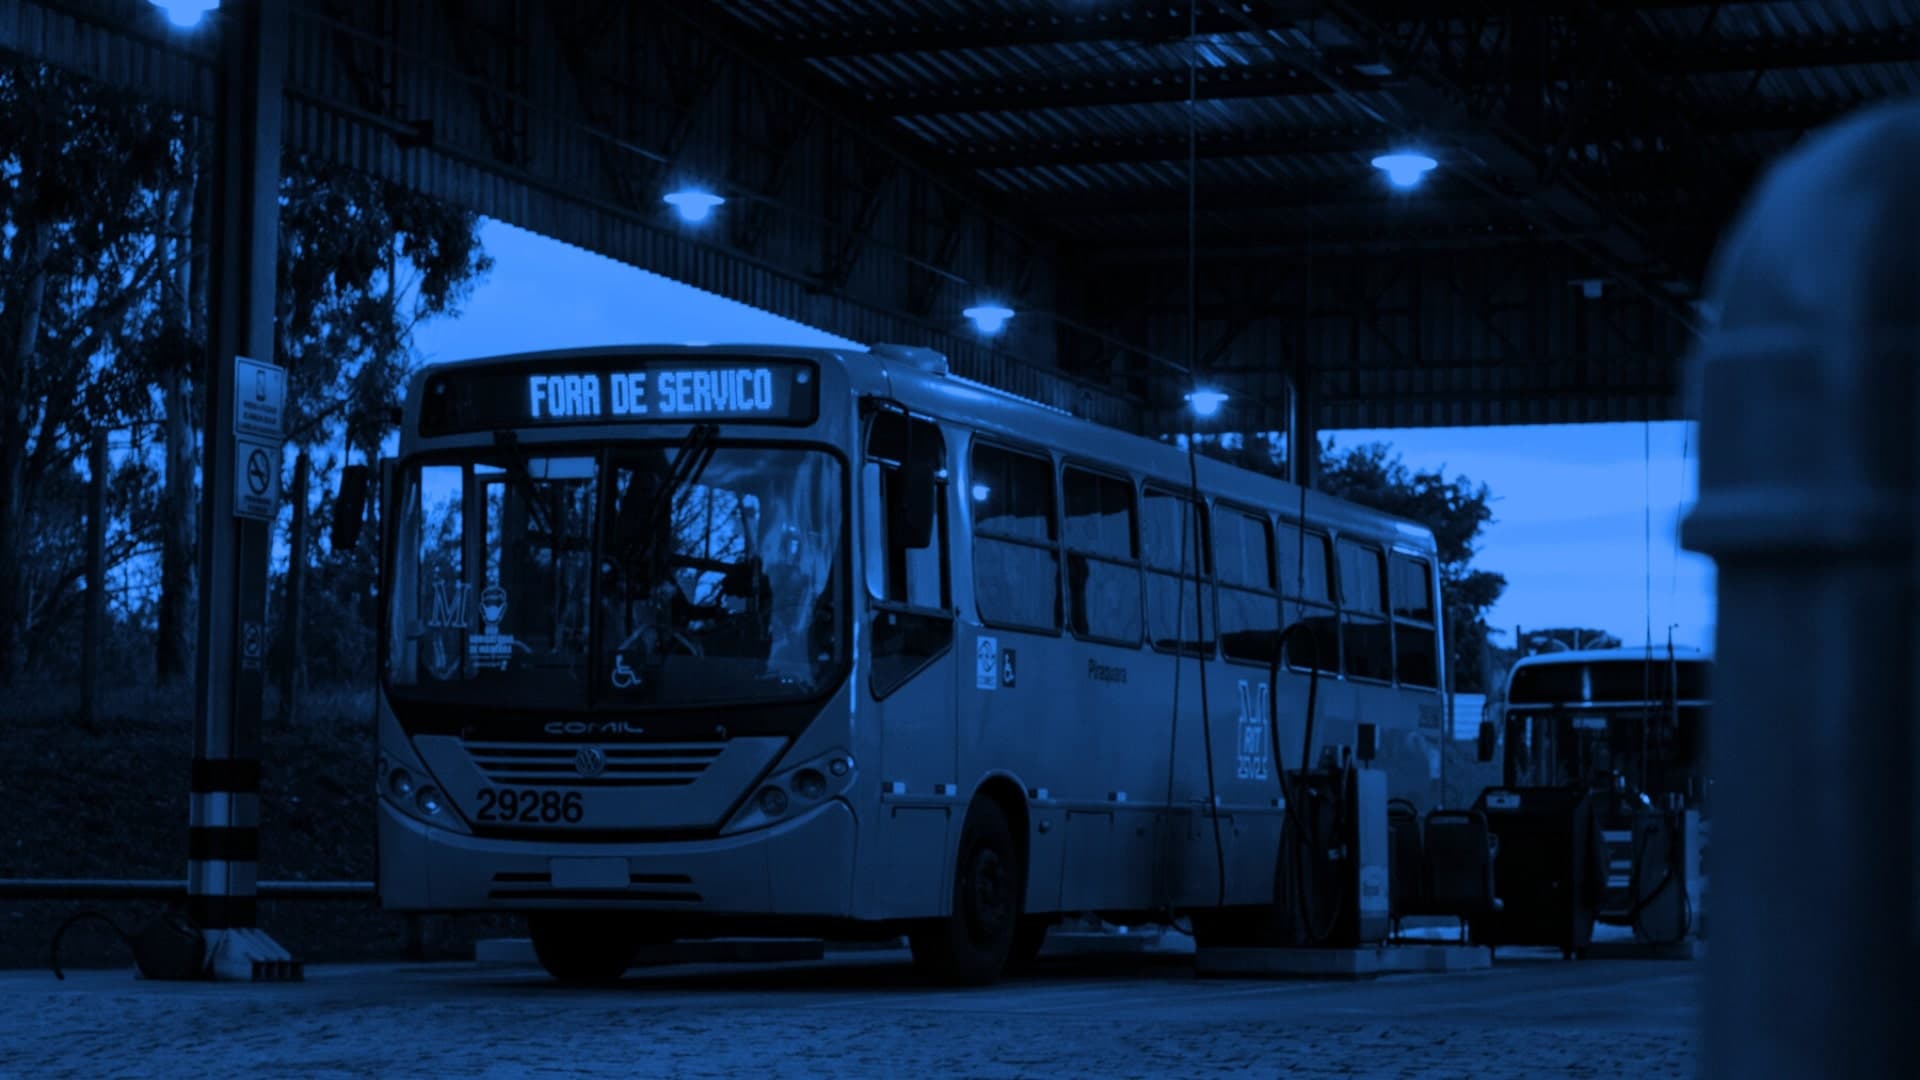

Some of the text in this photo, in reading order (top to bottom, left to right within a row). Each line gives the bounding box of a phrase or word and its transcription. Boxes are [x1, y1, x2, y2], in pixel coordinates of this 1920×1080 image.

[529, 368, 773, 419] FORA DE SERVICO
[543, 720, 645, 735] COMIL
[476, 788, 584, 823] 29286
